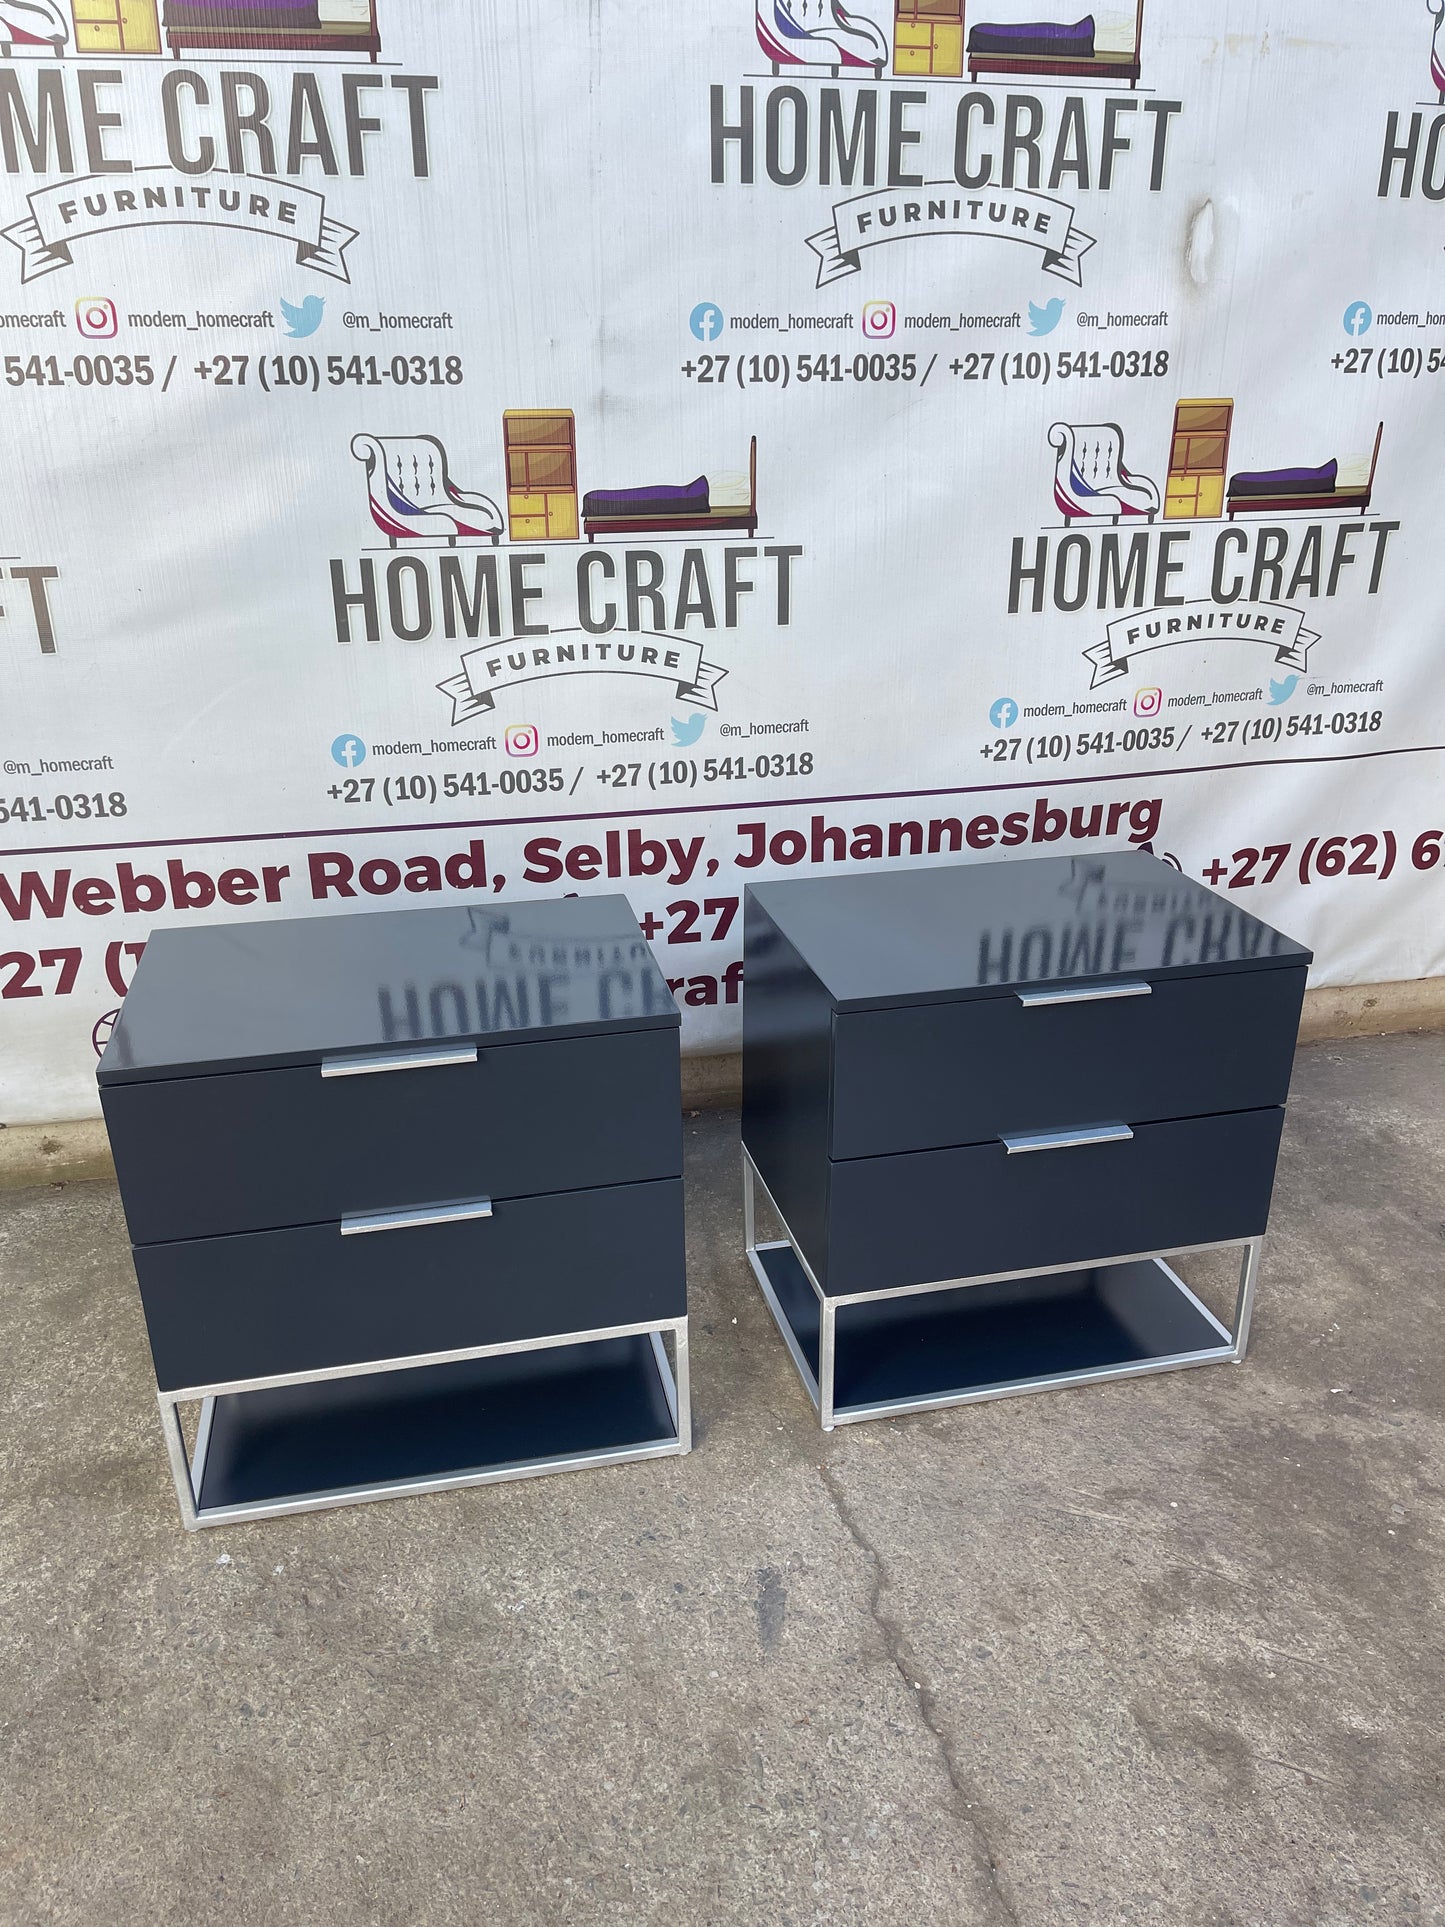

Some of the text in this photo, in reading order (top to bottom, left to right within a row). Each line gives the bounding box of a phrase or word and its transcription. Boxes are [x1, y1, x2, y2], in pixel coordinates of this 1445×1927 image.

[161, 69, 439, 178] CRAFT
[710, 84, 1182, 192] HOME CRAFT
[58, 185, 298, 225] FURNITURE
[857, 199, 1052, 234] FURNITURE
[342, 311, 454, 332] @m_homecraft
[1076, 310, 1169, 330] @m_homecraft
[4, 354, 154, 387] 541-0035
[194, 355, 250, 386] +27
[258, 355, 320, 392] (10)
[327, 354, 464, 386] 541-0318
[681, 354, 730, 384] +27
[737, 355, 790, 388] (10)
[796, 352, 917, 383] 541-0035
[949, 351, 998, 382] +27
[1001, 351, 1051, 385] (10)
[1056, 349, 1170, 380] 541-0318
[1330, 347, 1374, 374] +27
[1377, 347, 1423, 379] (10)
[1007, 520, 1400, 614] HOME CRAFT
[0, 565, 60, 654] T
[328, 544, 803, 644] HOME CRAFT
[1127, 612, 1286, 645] FURNITURE
[486, 642, 681, 678] FURNITURE
[1306, 679, 1384, 699] @m_homecraft
[719, 718, 810, 739] @m_homecraft
[979, 737, 1022, 762] +27
[1026, 734, 1072, 763] (10)
[1076, 726, 1176, 756] 541-0035
[1201, 720, 1240, 745] +27
[1241, 717, 1283, 744] (10)
[1286, 710, 1383, 737] 541-0318
[3, 755, 114, 776] @m_homecraft
[327, 777, 375, 804] +27
[383, 774, 437, 806] (10)
[443, 767, 564, 798] 541-0035
[597, 762, 643, 789] +27
[648, 760, 698, 790] (10)
[702, 752, 814, 782] 541-0318
[0, 797, 1163, 922] Webber Road, Selby, Johannesburg
[1202, 829, 1445, 890] +27 (62) 6
[639, 896, 740, 945] +27
